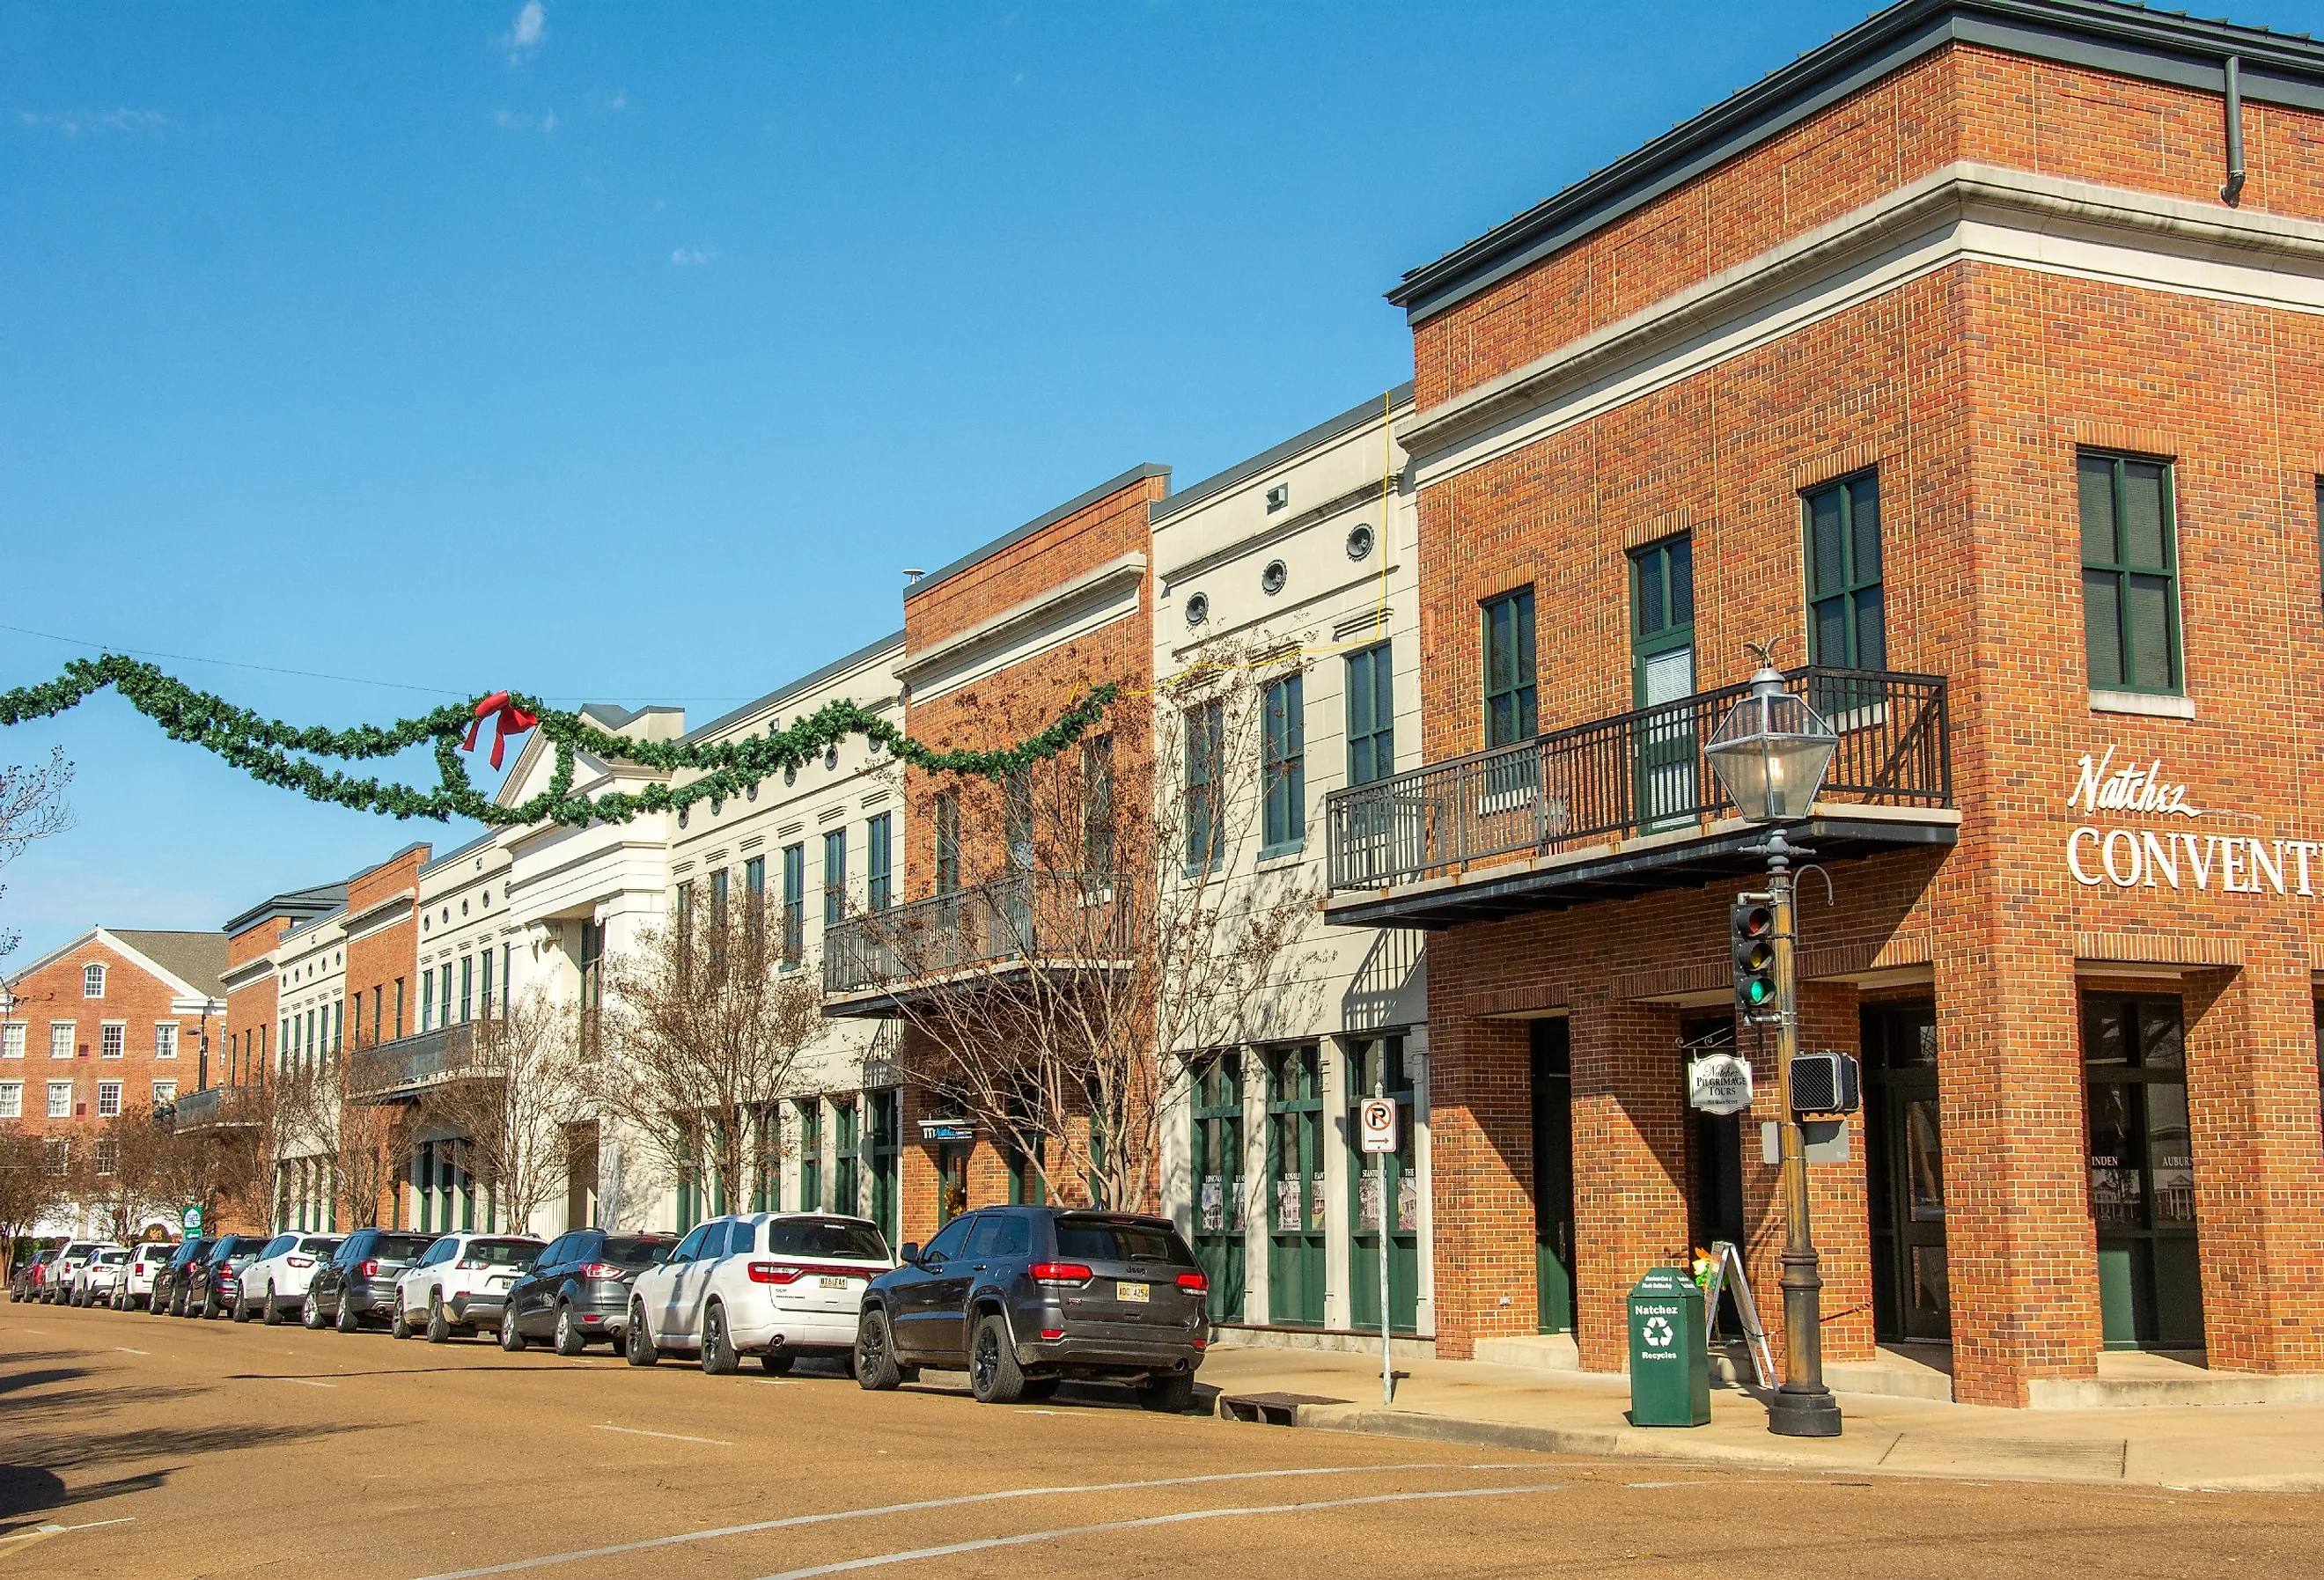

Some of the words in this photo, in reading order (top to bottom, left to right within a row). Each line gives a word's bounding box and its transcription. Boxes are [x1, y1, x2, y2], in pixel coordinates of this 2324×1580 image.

[2067, 743, 2202, 818] Natchez
[2067, 827, 2324, 897] CONVENT
[1703, 1063, 1739, 1078] Natchez
[1696, 1077, 1747, 1087] PILGRIMAGE
[1708, 1086, 1736, 1097] TOURS
[2091, 1156, 2118, 1166] INDEN
[1635, 1304, 1679, 1315] Natchez
[1641, 1351, 1677, 1360] Recycles
